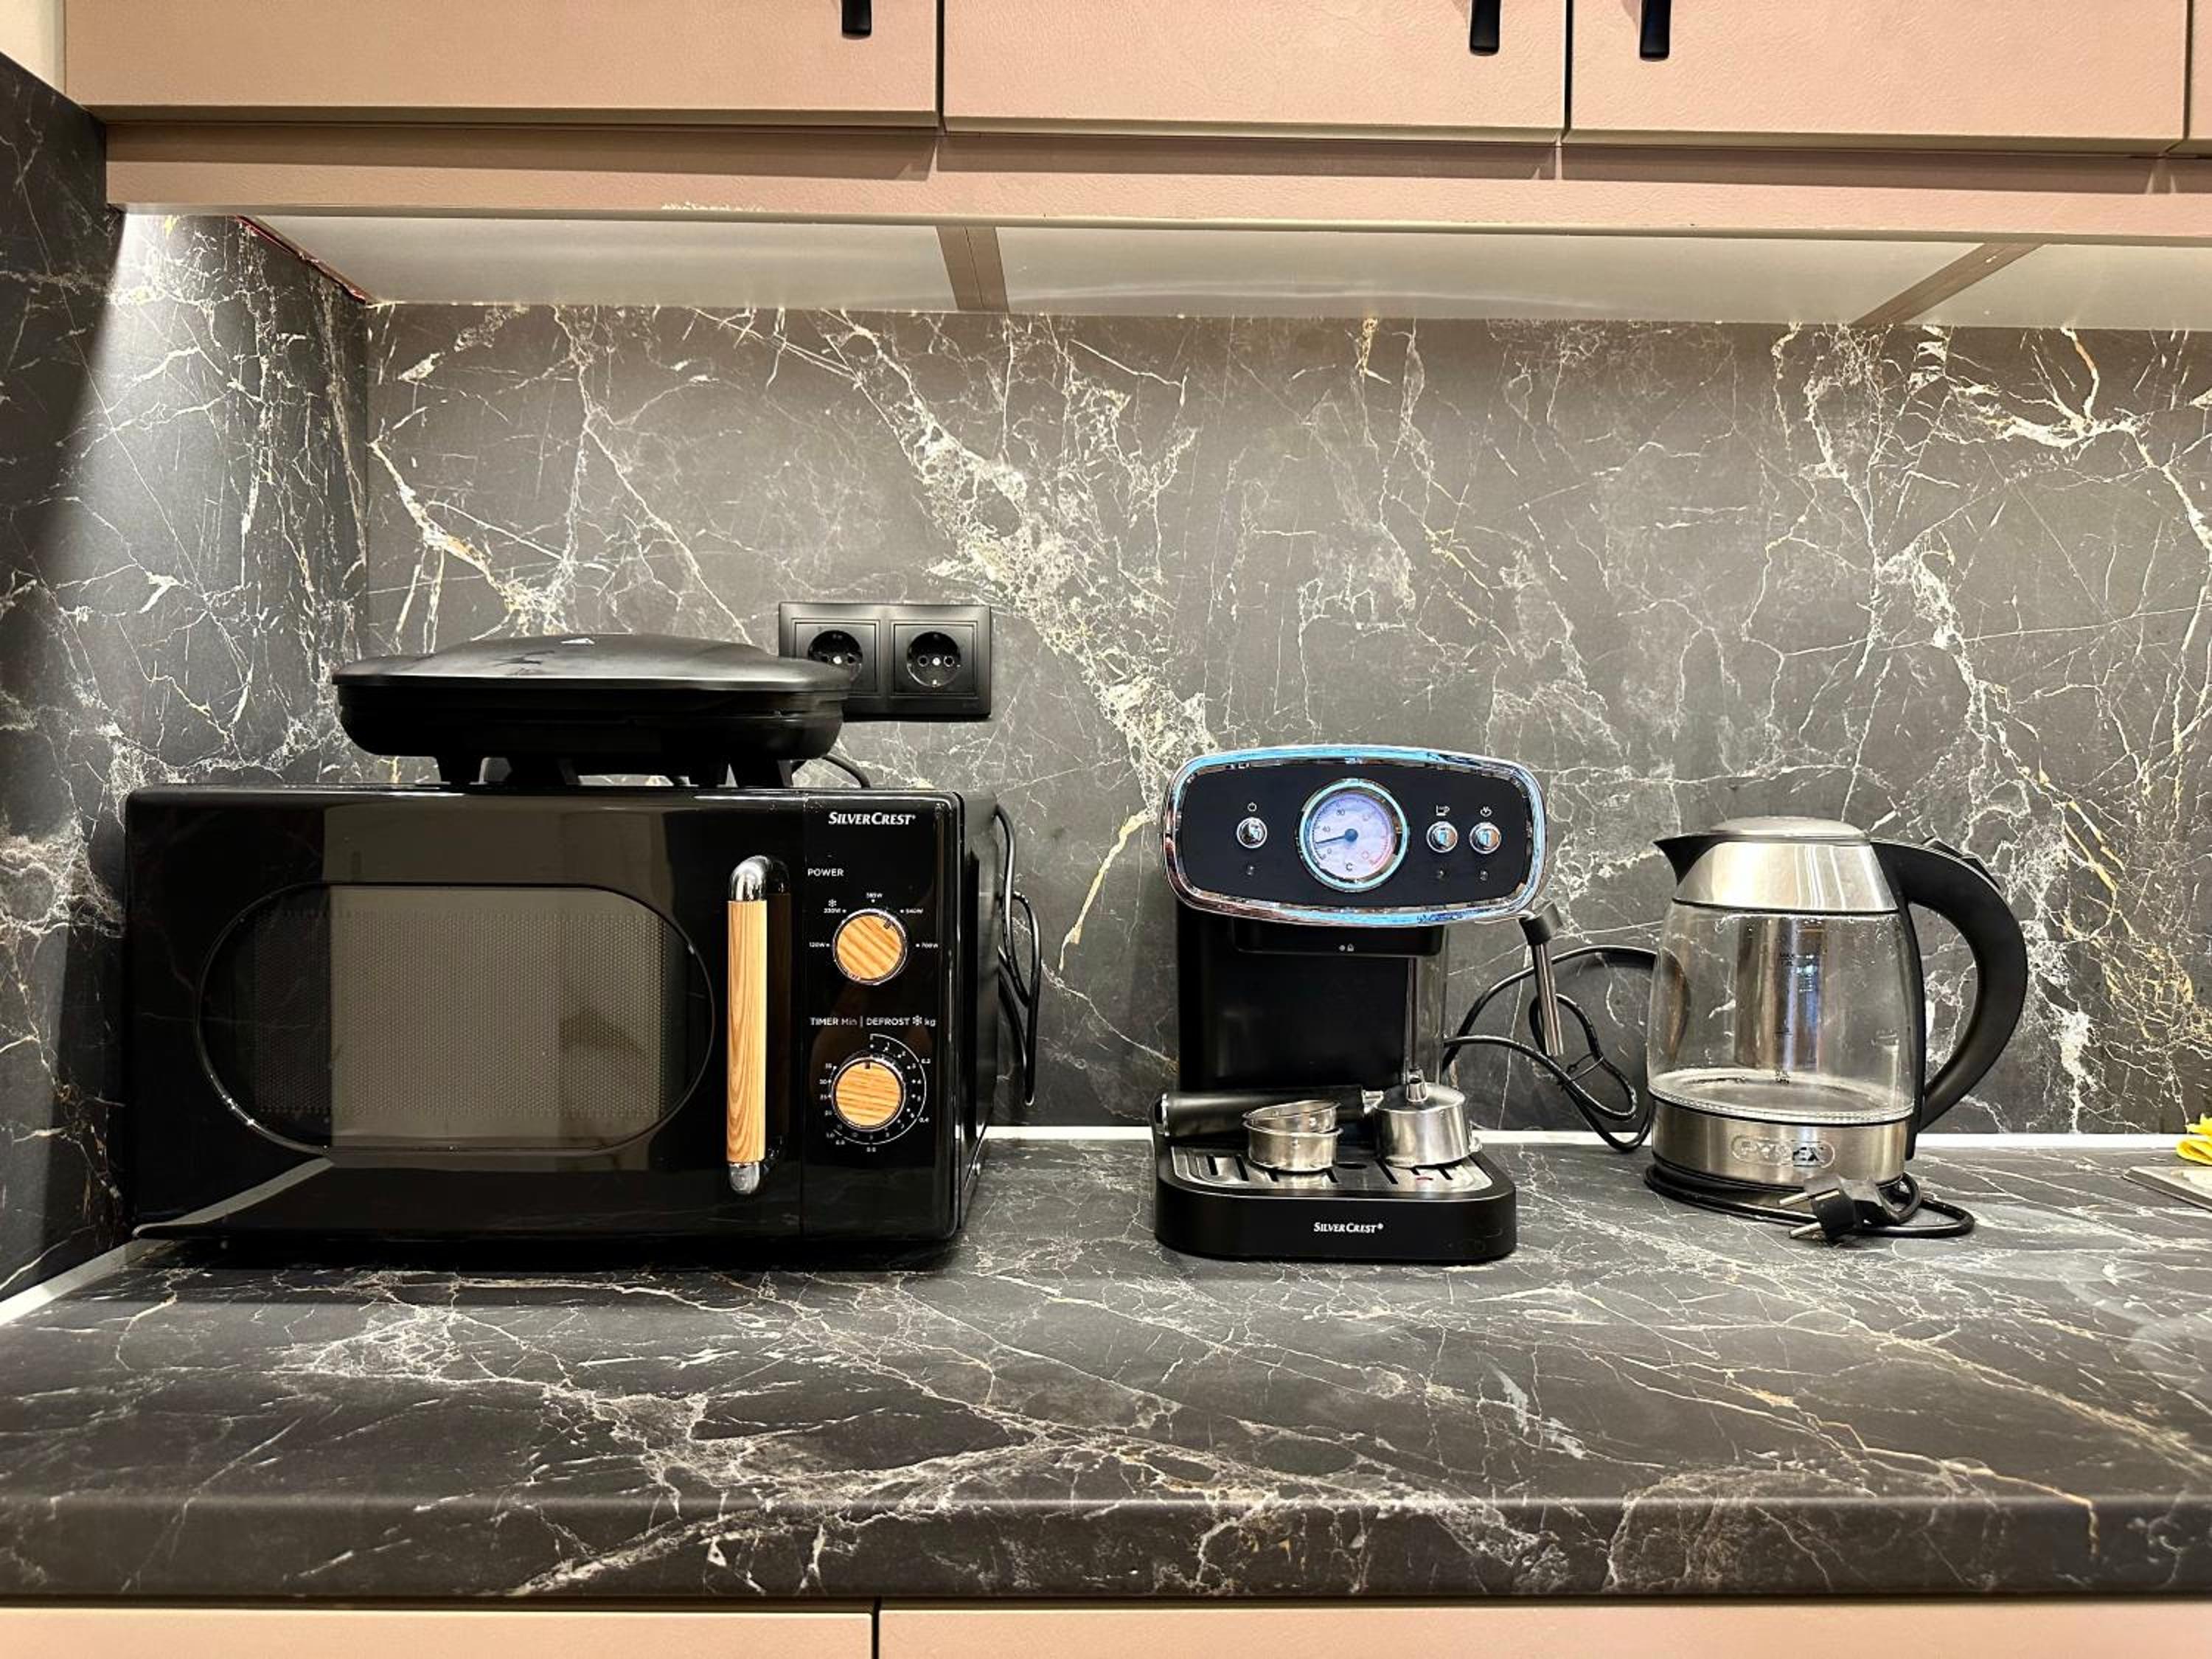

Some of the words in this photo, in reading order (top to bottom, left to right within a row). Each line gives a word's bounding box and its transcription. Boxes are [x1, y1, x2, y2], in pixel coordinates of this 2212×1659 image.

[828, 812, 911, 825] SILVERCREST
[807, 868, 844, 877] POWER
[810, 1017, 838, 1026] TIMER
[866, 1017, 911, 1026] DEFROST
[924, 1018, 936, 1027] kg
